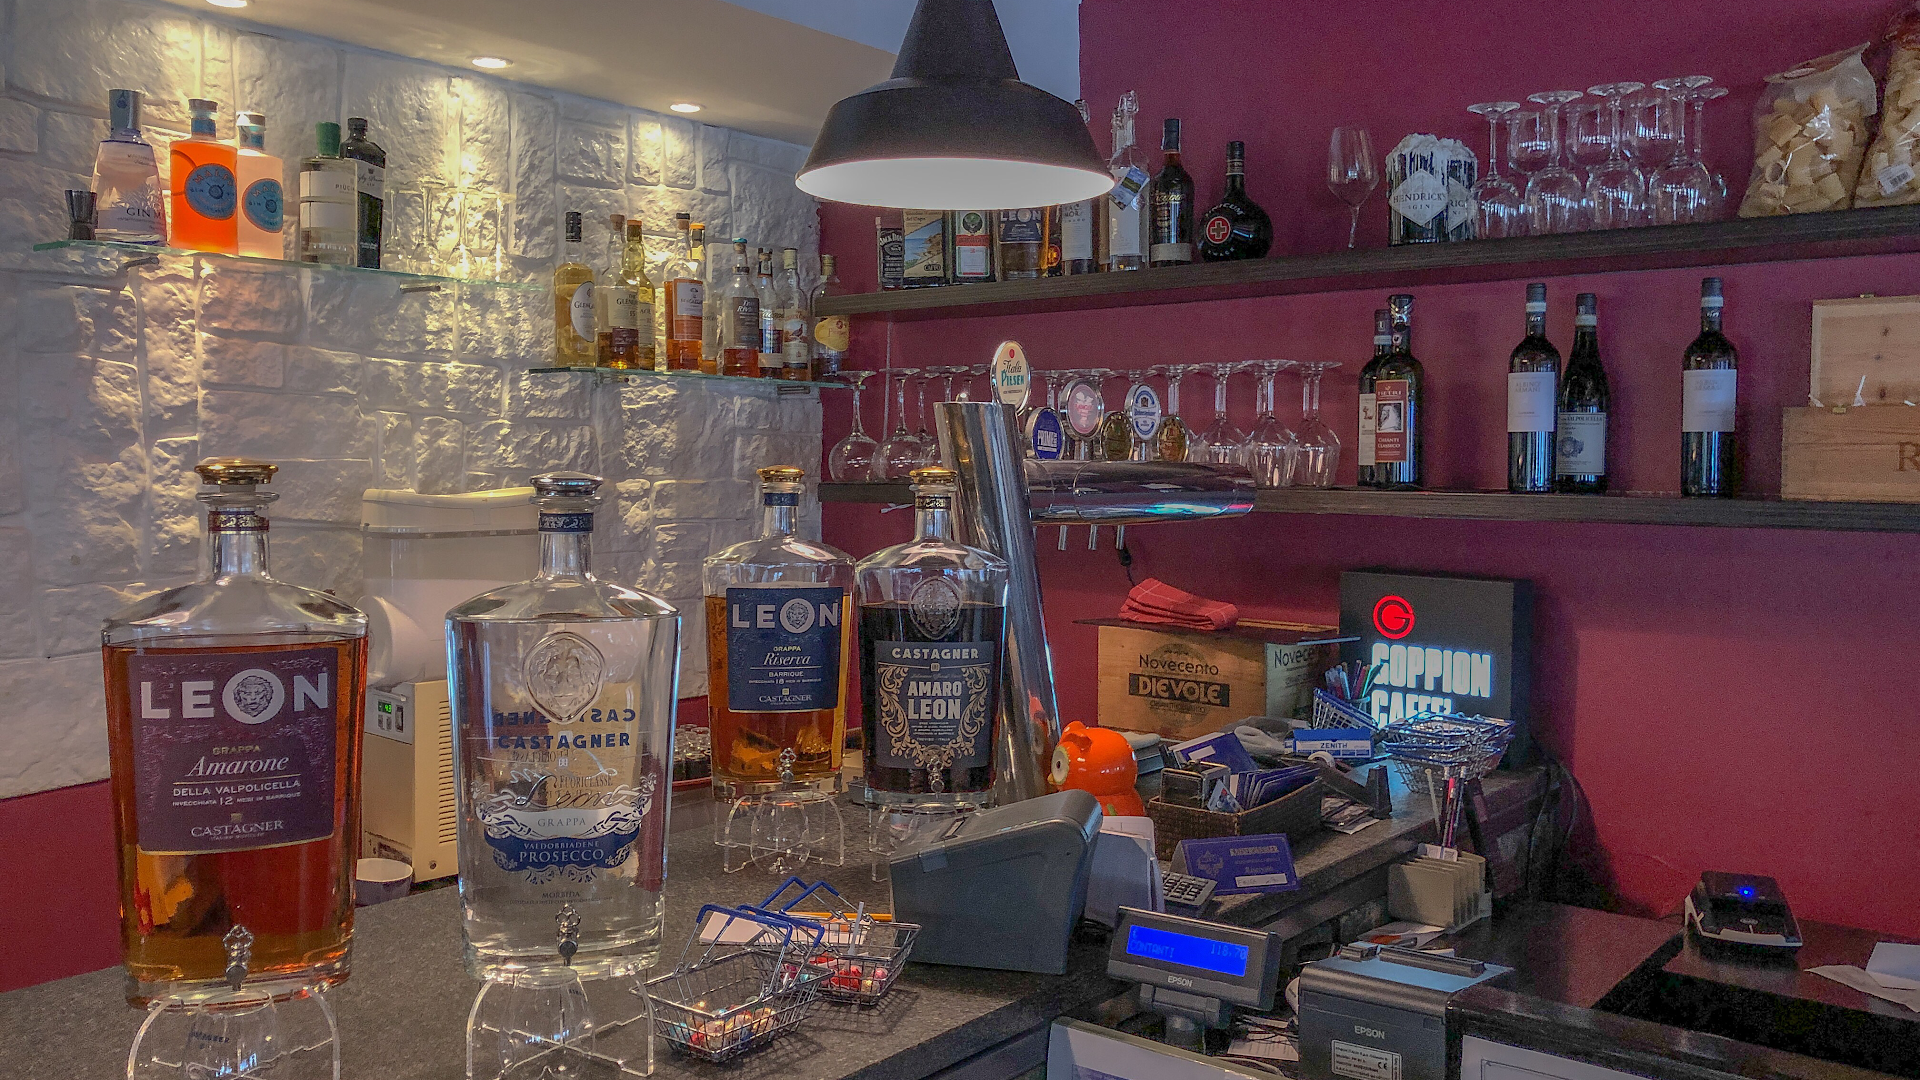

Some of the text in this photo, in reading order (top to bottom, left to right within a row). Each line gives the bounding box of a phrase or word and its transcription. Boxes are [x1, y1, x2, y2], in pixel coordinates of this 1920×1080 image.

[1393, 192, 1447, 204] HENDRICK'S
[126, 206, 151, 218] GIN
[1000, 208, 1041, 223] LEON
[1001, 370, 1025, 387] PILSEN
[1895, 440, 1920, 472] R
[732, 598, 840, 634] LEON
[762, 652, 811, 666] Riserva
[891, 647, 979, 660] CASTAGNER
[1138, 653, 1219, 676] Novecento
[1371, 642, 1491, 698] GOPPION
[140, 668, 329, 725] LEON
[907, 680, 963, 697] AMARO
[1137, 675, 1221, 705] DIEVOLE
[758, 694, 813, 704] CASTAGNER
[907, 698, 961, 720] LEON
[497, 732, 631, 750] CASTAGNER
[212, 744, 262, 756] GRAPPA
[184, 755, 290, 777] Amarone
[172, 779, 301, 797] DELLA VALPOLICELLA
[219, 796, 234, 806] 12
[190, 819, 285, 838] CASTAGNER
[537, 817, 587, 828] GRAPPA
[523, 840, 600, 850] VALDOBBIADENE
[519, 848, 605, 863] PROSECCO
[541, 890, 581, 899] MORBIDA
[1129, 938, 1175, 958] CONTANTI
[1167, 975, 1193, 988] EPSON
[1354, 1024, 1386, 1040] EPSON
